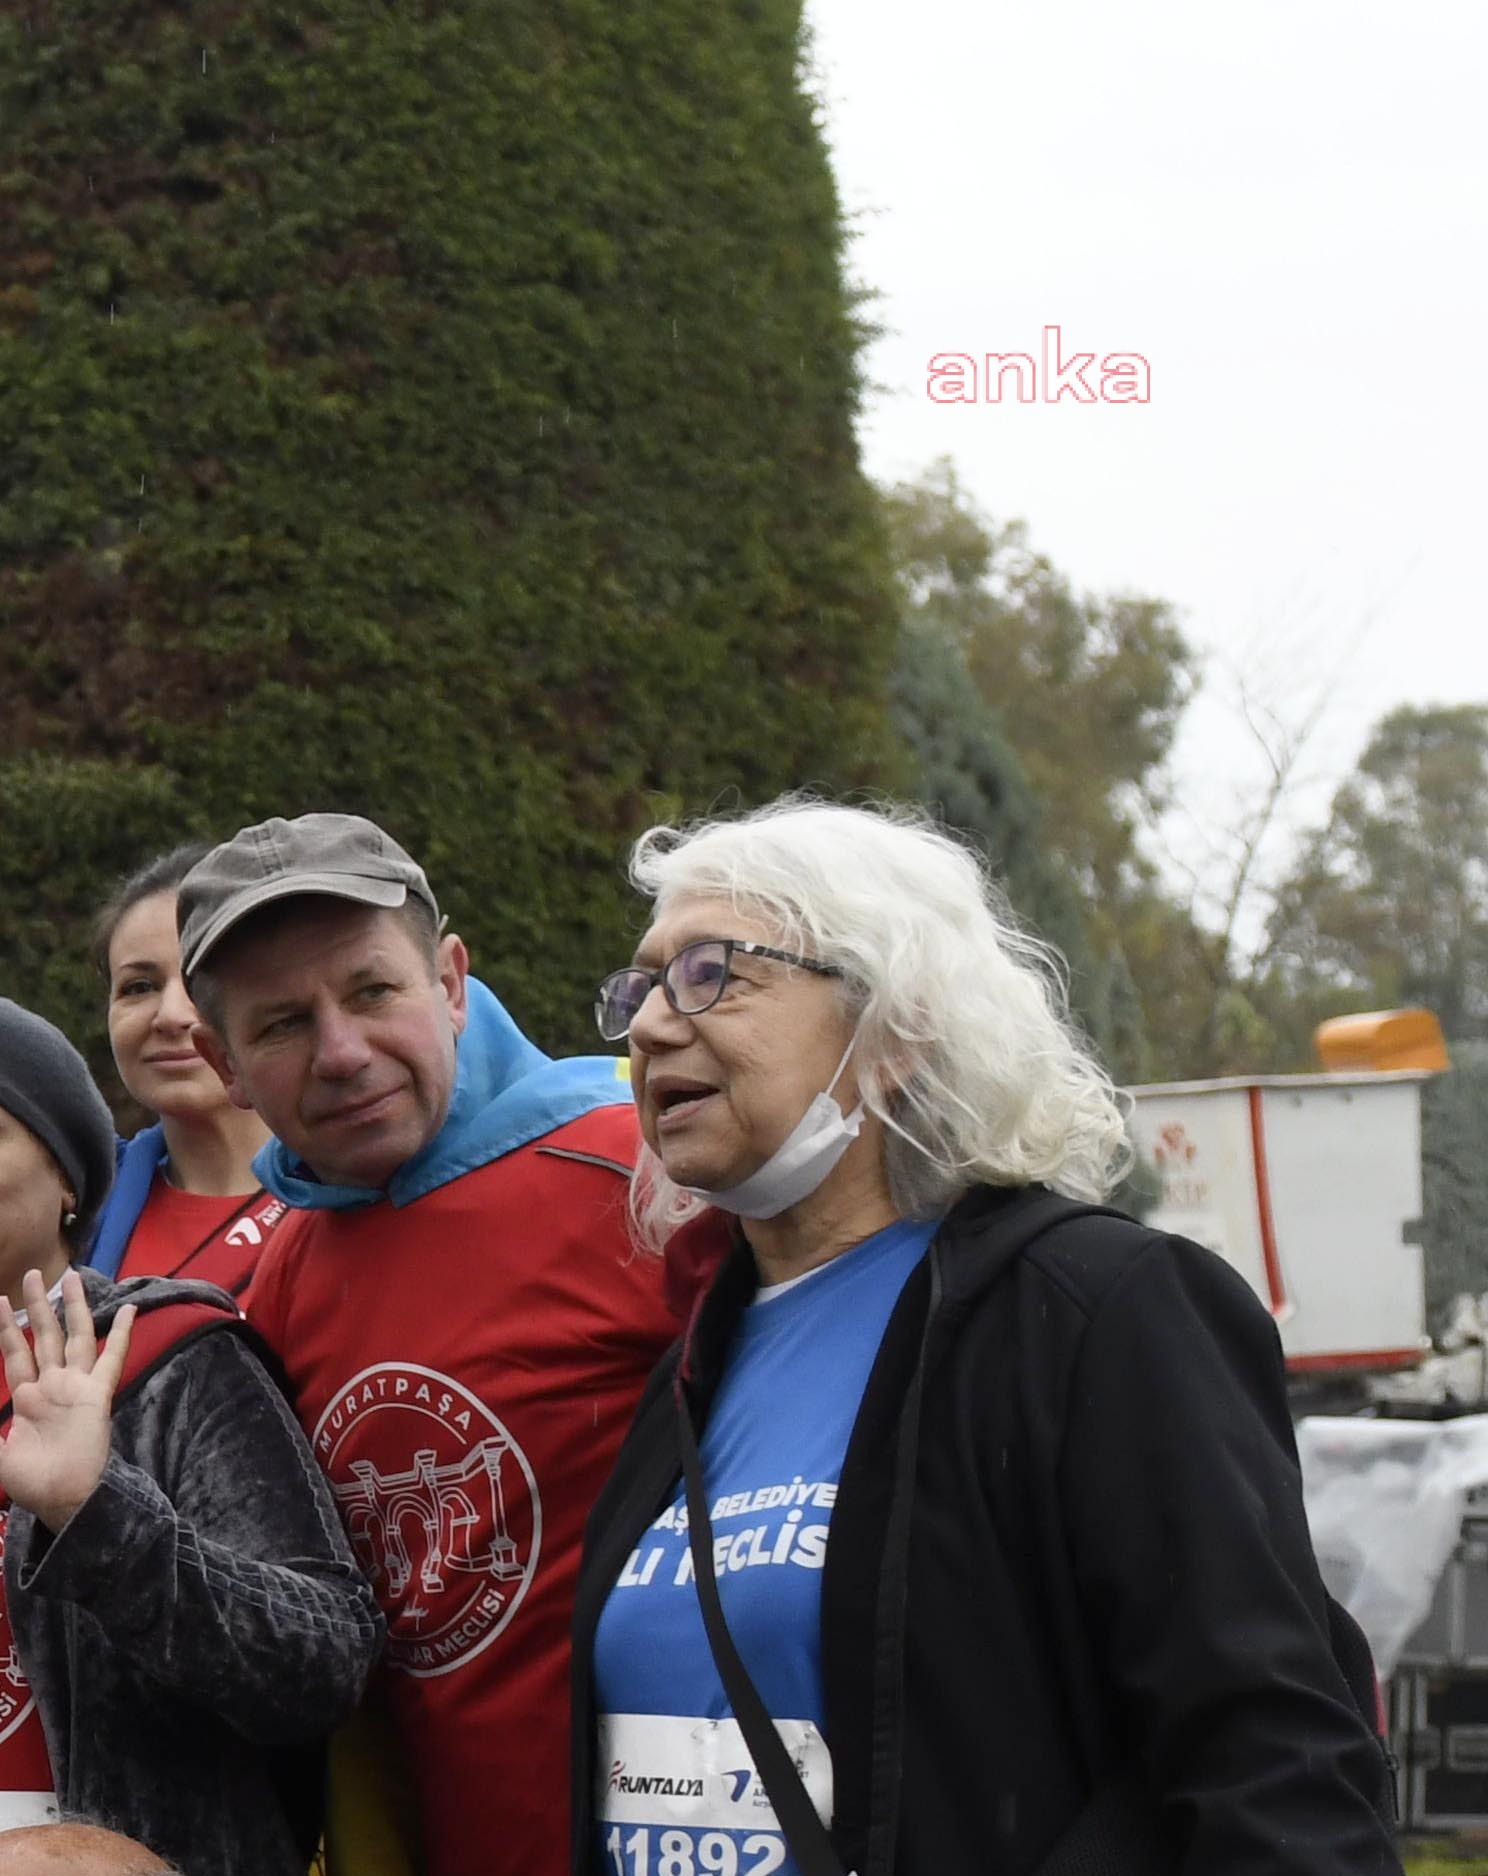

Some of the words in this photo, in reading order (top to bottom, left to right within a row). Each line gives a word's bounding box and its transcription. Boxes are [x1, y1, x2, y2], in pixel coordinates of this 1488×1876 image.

[319, 1377, 472, 1453] MURATPAŞA
[438, 1588, 507, 1658] MECLİSİ
[618, 1776, 704, 1796] RUNTALYA
